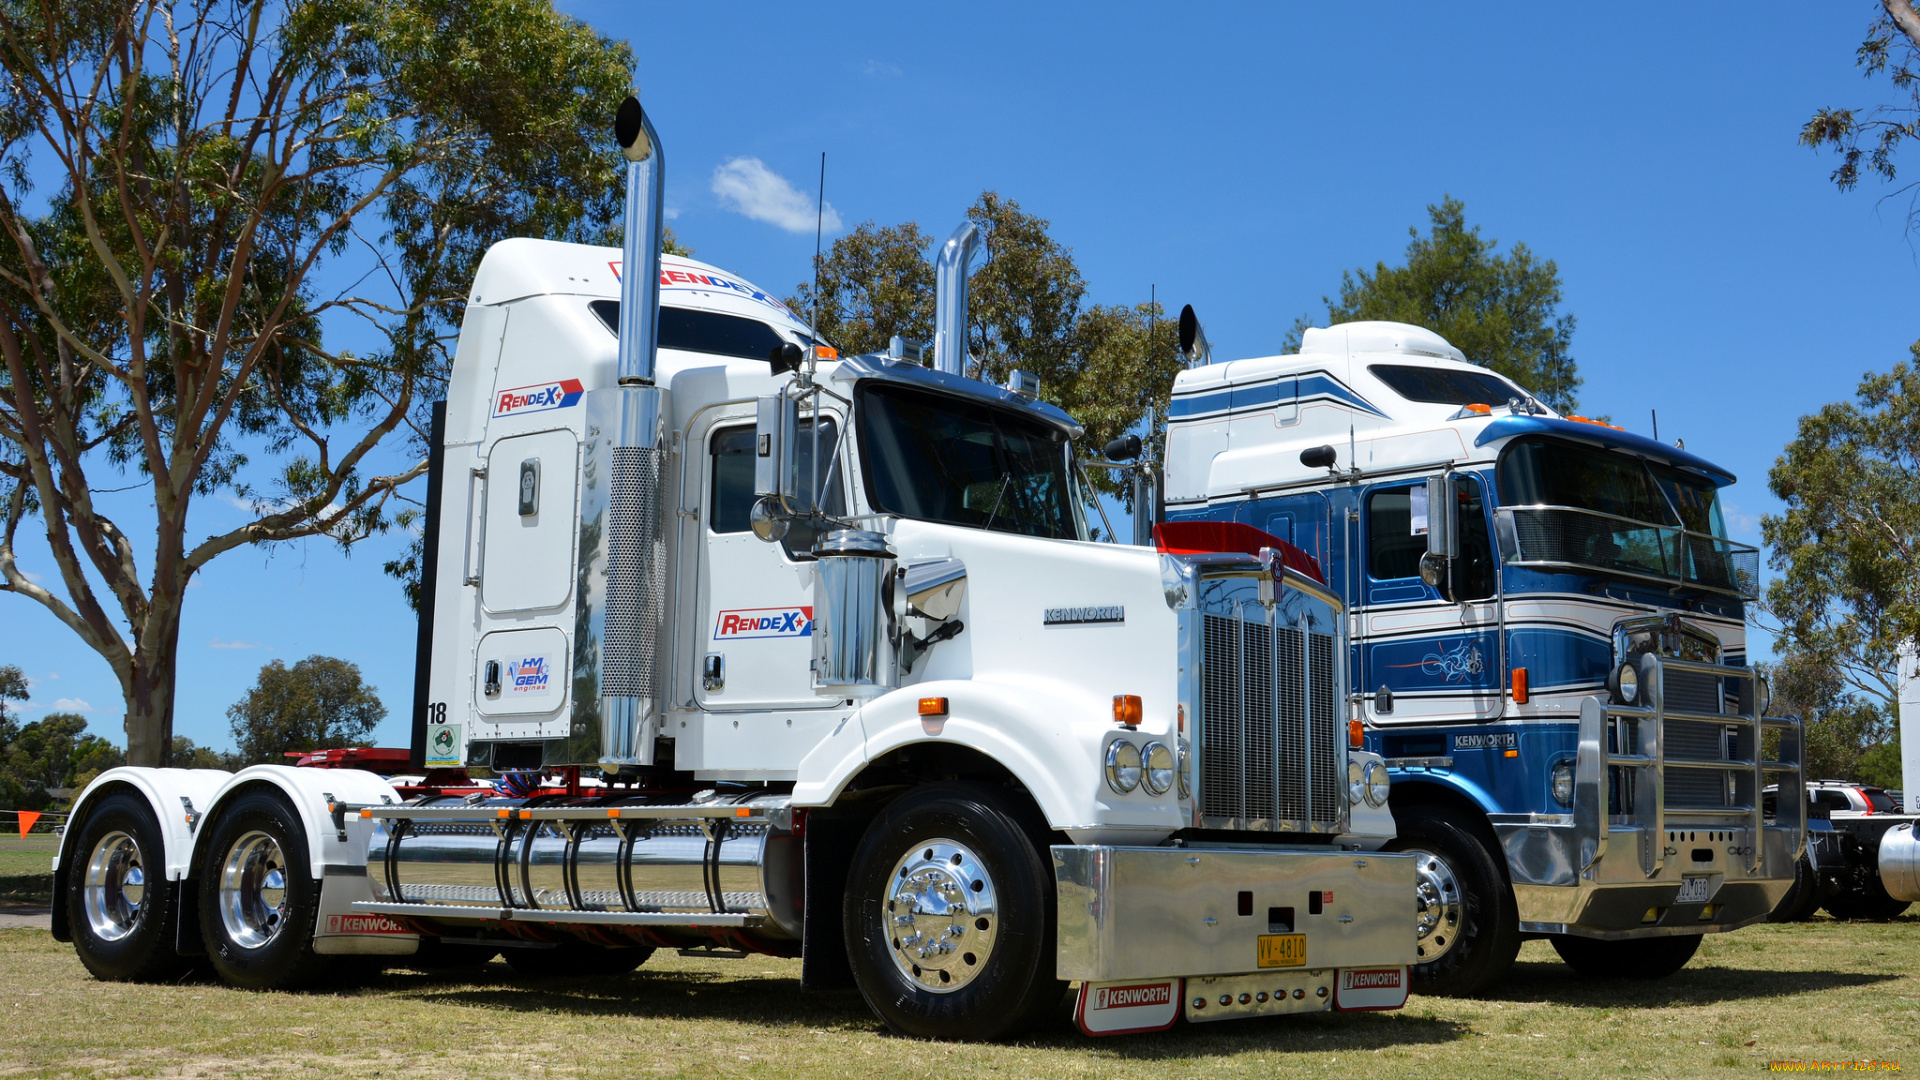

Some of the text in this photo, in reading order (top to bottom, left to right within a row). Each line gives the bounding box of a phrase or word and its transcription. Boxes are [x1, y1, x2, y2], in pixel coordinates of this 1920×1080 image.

[1044, 605, 1124, 622] KENWORTH
[522, 657, 543, 675] HM
[515, 675, 549, 686] GEM
[429, 702, 447, 724] 18
[1455, 733, 1516, 748] KENWORTH
[343, 918, 406, 931] KENWOR
[1354, 972, 1400, 986] KENWORTH
[1109, 986, 1169, 1005] KENWORTH
